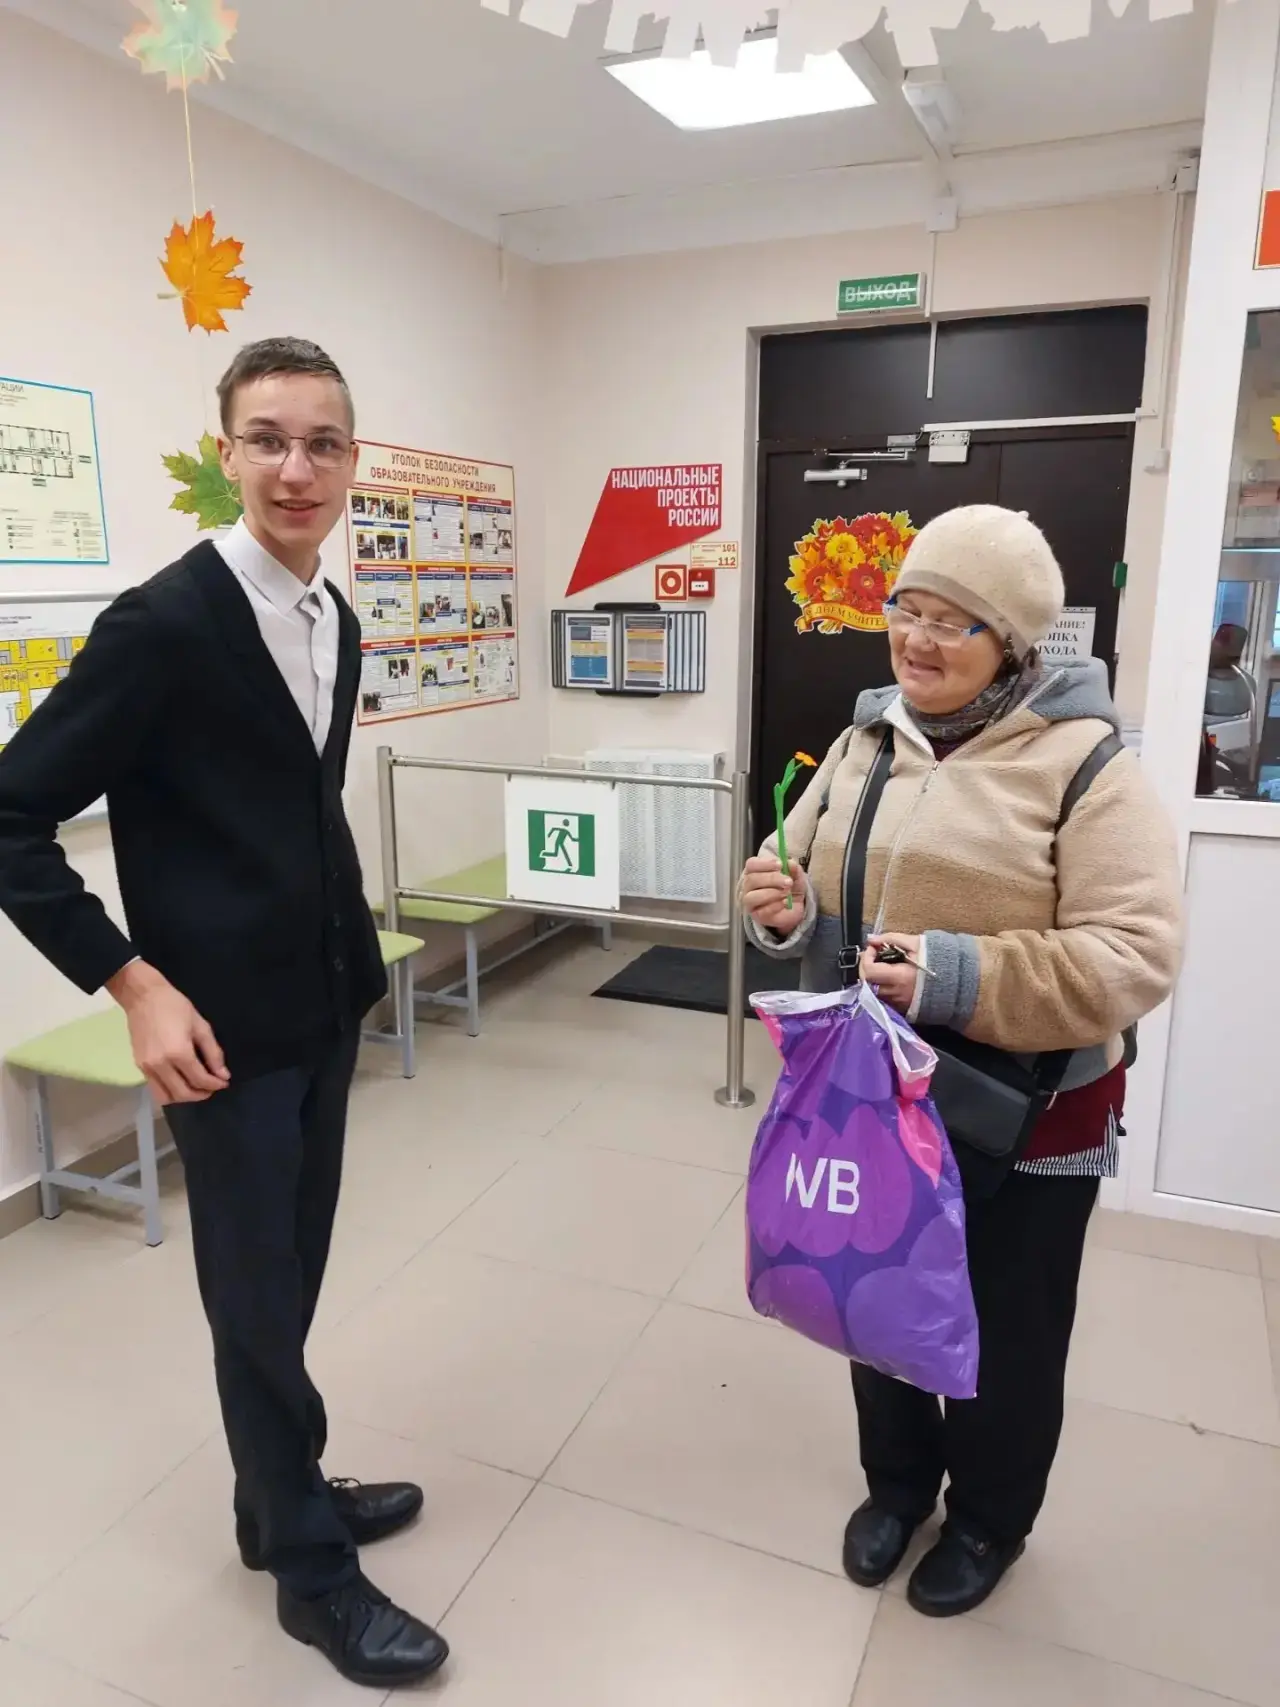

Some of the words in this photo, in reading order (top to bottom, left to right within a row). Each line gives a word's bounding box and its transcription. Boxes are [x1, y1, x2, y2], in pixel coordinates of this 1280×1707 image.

[845, 281, 911, 303] ВЫХОД
[391, 452, 421, 468] УГОЛОК
[425, 458, 479, 476] БЕЗОПАСНОСТИ
[370, 466, 450, 488] ОБРАЗОВАТЕЛЬНОГО
[452, 478, 496, 493] УЧРЕЖДЕНИЯ
[611, 466, 719, 490] НАЦИОНАЛЬНЫЕ
[657, 486, 719, 508] ПРОЕКТЫ
[668, 508, 719, 527] РОССИИ
[722, 543, 736, 552] 101
[718, 556, 736, 566] 112
[1038, 645, 1077, 655] ХОДА
